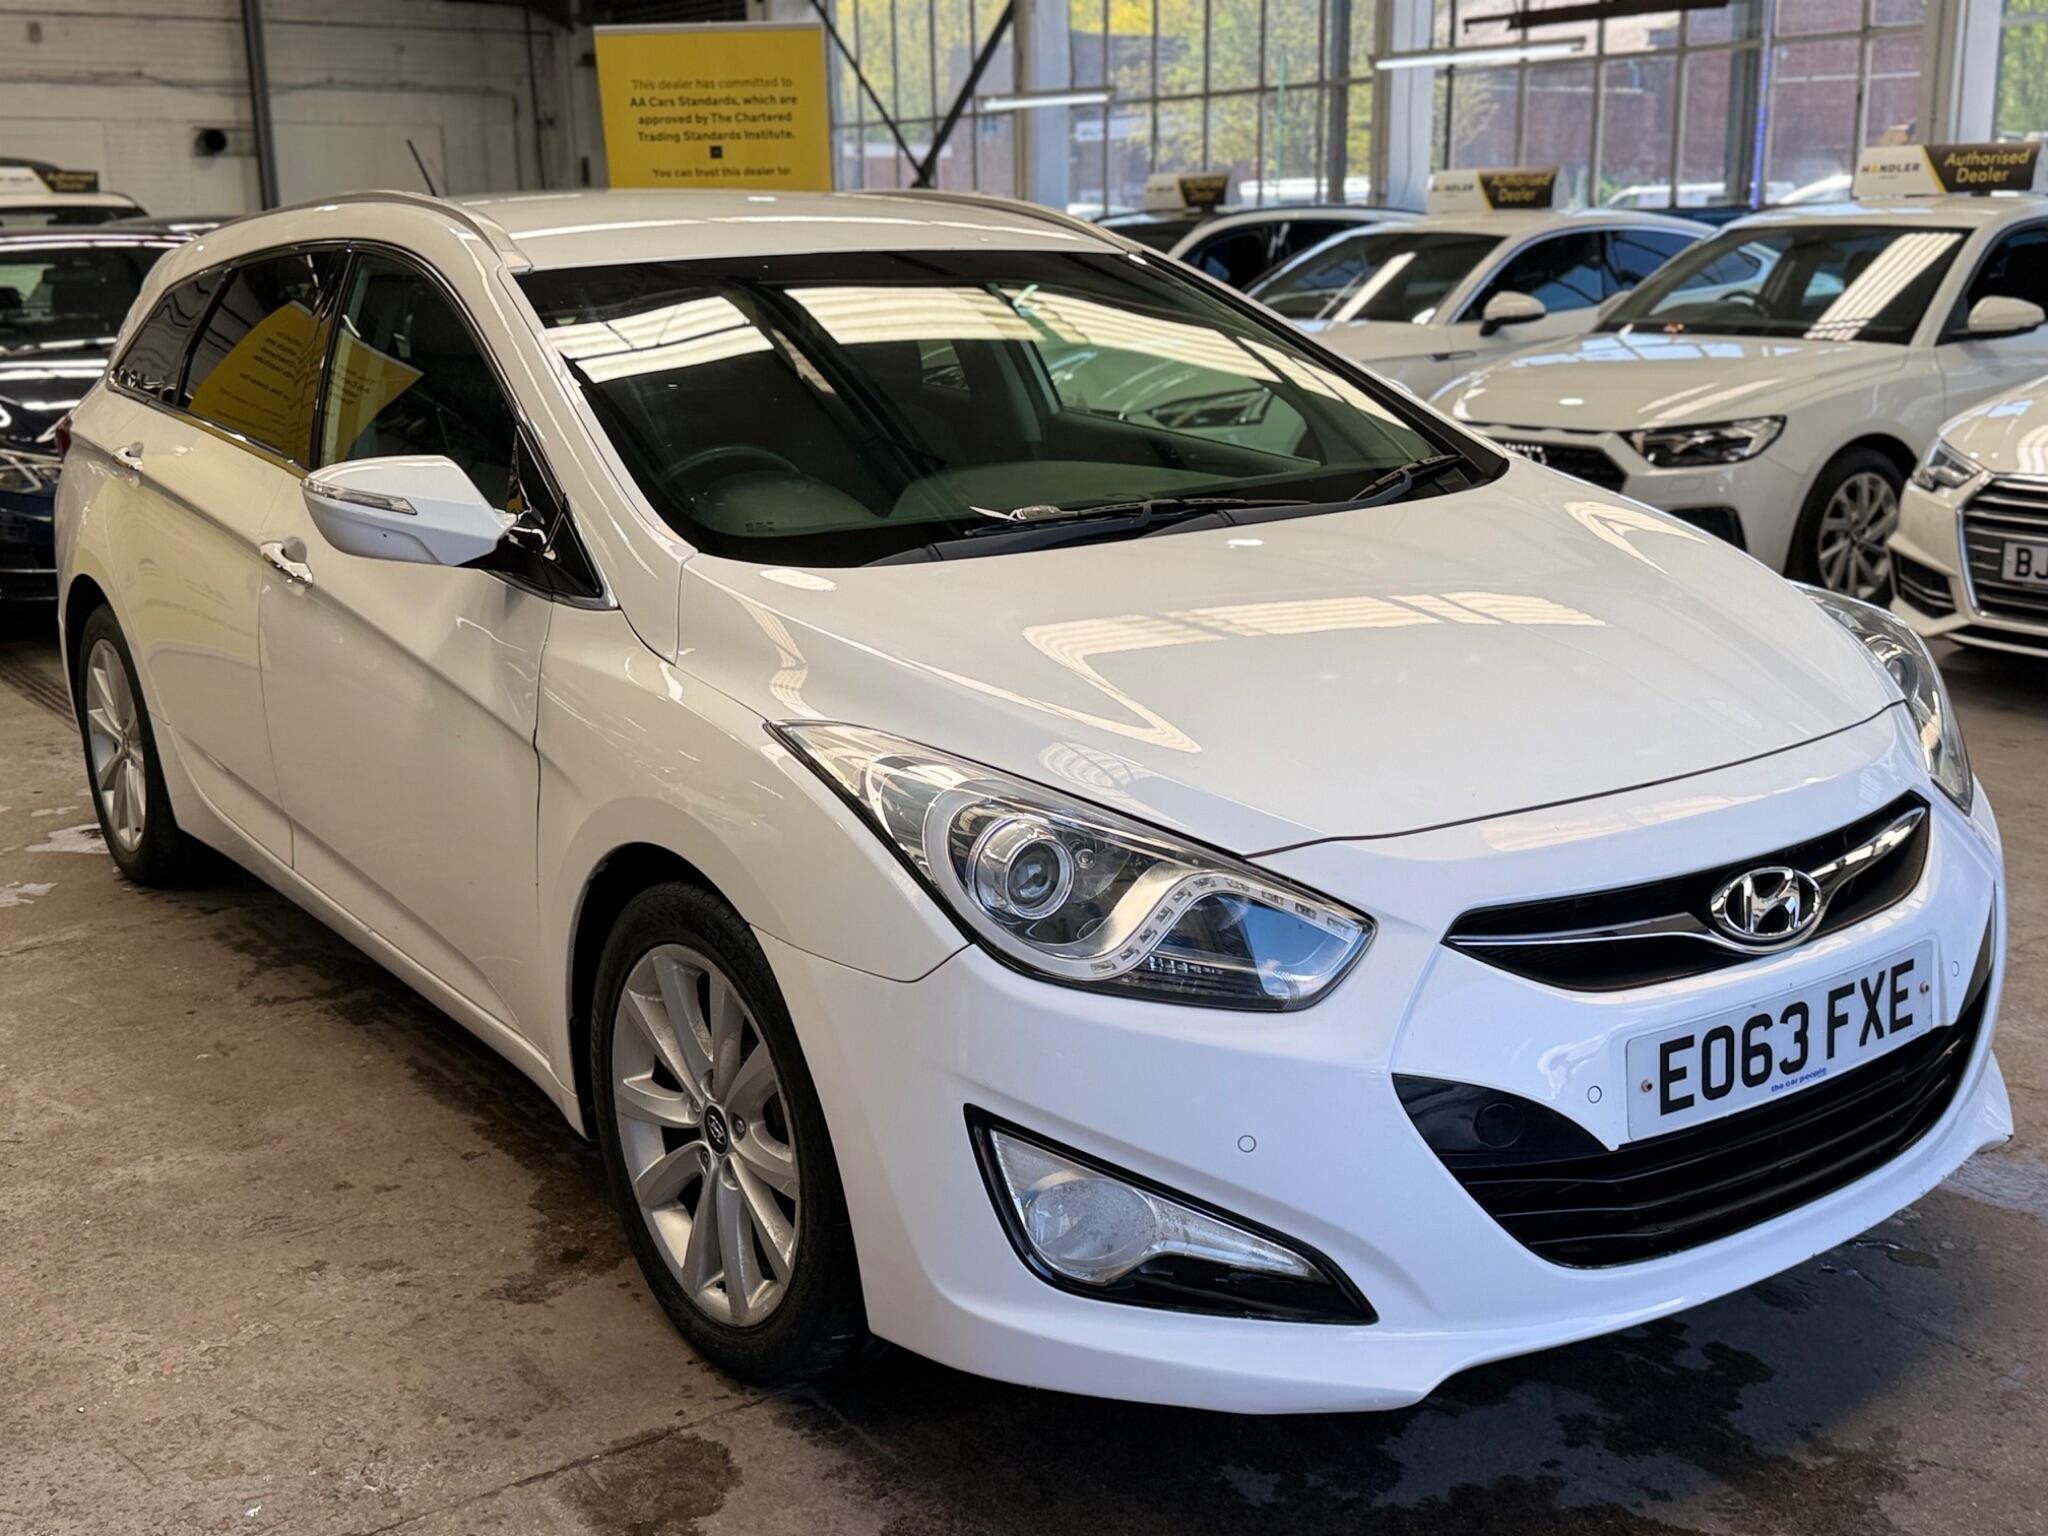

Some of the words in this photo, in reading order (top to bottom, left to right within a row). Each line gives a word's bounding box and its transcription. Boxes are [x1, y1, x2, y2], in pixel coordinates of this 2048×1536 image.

[632, 79, 655, 90] This
[659, 79, 692, 90] dealer
[695, 79, 715, 89] has
[718, 77, 778, 89] committed
[781, 77, 793, 88] to
[630, 97, 646, 108] AA
[649, 96, 675, 107] Cars
[743, 94, 777, 105] which
[780, 96, 798, 105] are
[638, 114, 692, 126] approved
[695, 114, 708, 126] by
[711, 112, 732, 123] The
[735, 111, 792, 122] Chartered
[637, 131, 680, 143] Trading
[683, 131, 742, 141] Standards
[1943, 147, 2032, 167] Authorised
[653, 168, 672, 178] You
[674, 169, 693, 177] can
[695, 168, 719, 177] trust
[721, 167, 741, 177] this
[743, 167, 775, 176] dealer
[1956, 166, 2010, 184] Dealer
[1826, 958, 1915, 1060] FXE
[1770, 1082, 1784, 1092] the
[1785, 1077, 1799, 1087] car
